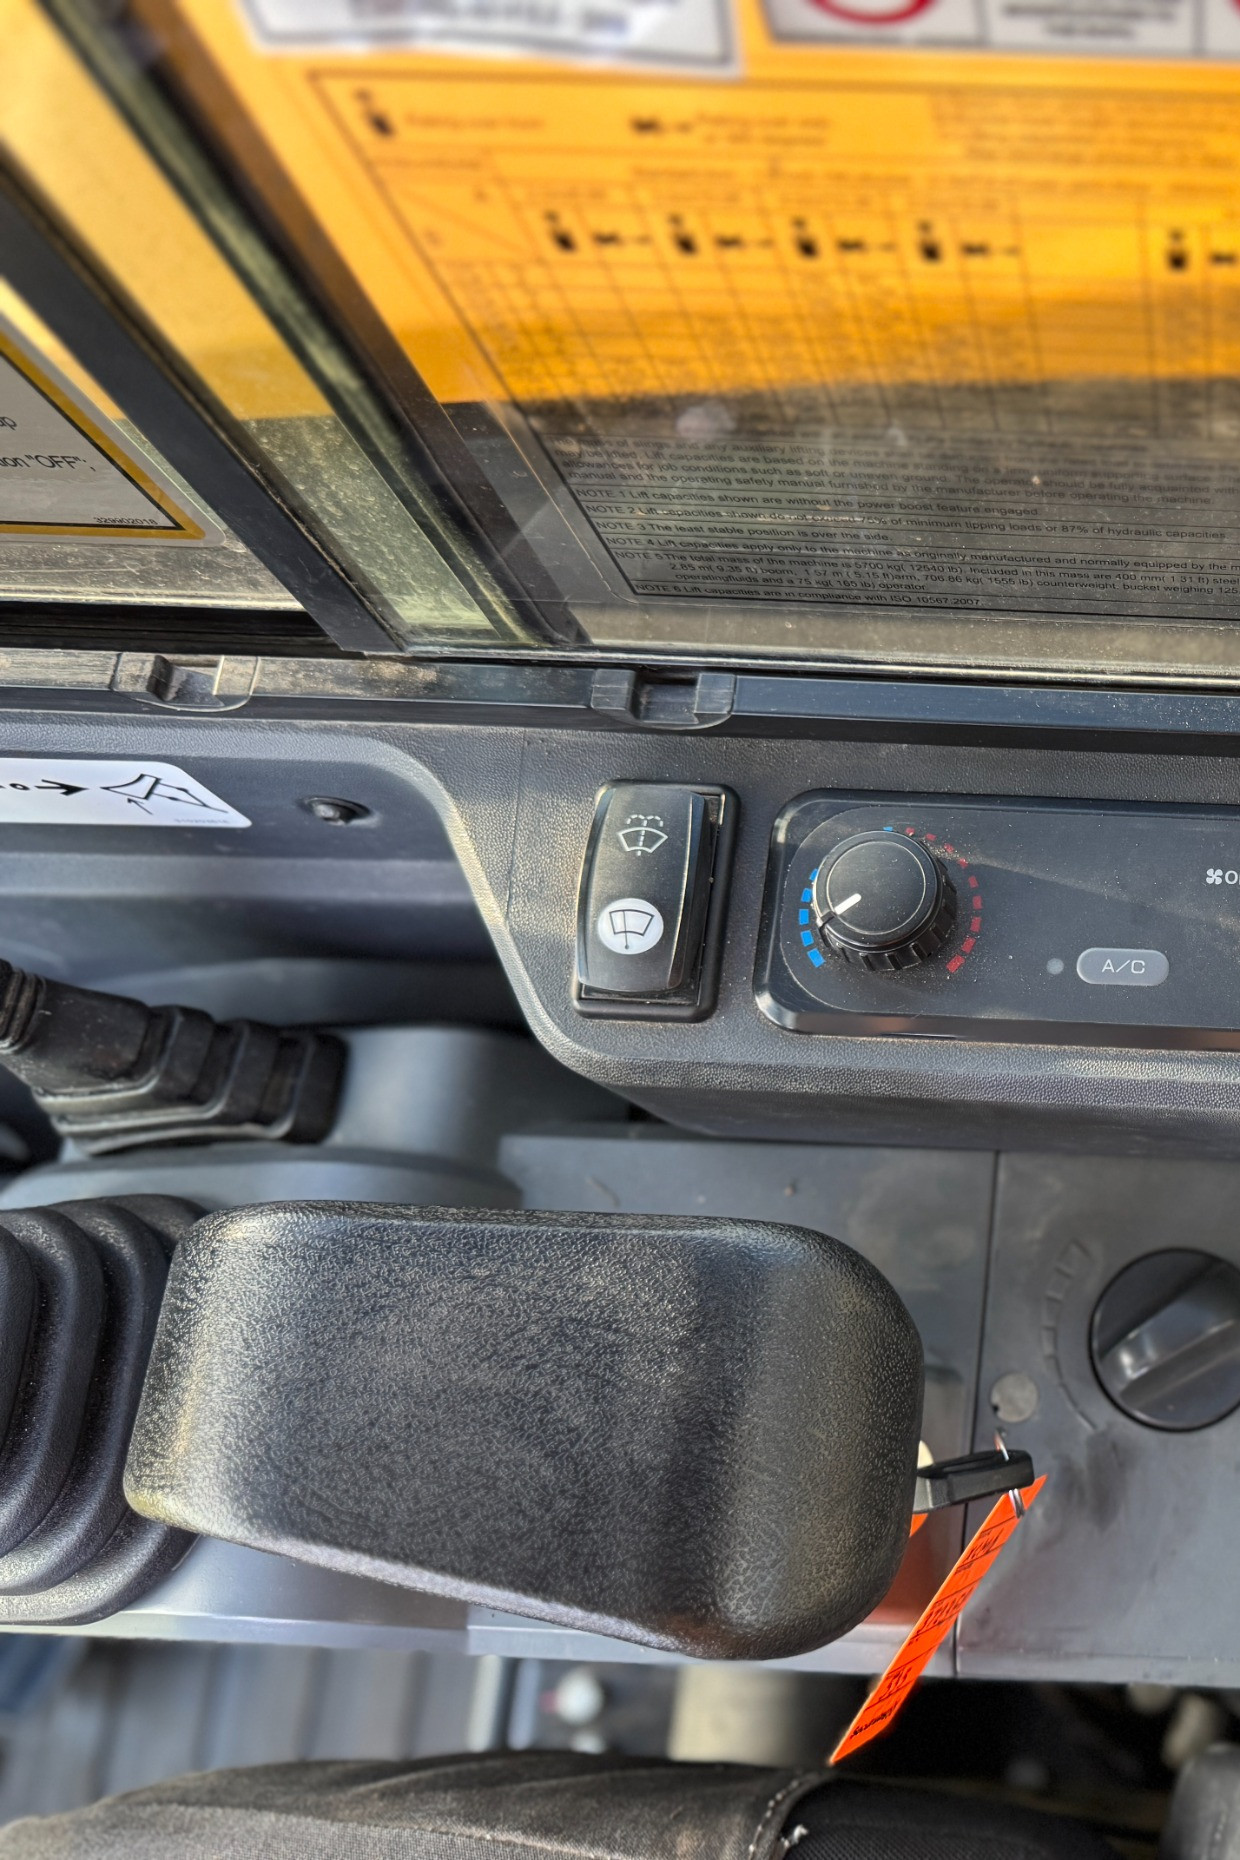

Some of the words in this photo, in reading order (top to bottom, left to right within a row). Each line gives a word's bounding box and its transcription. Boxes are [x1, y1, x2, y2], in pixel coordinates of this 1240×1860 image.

[574, 488, 617, 498] NOTE
[629, 491, 650, 499] Lift
[651, 492, 715, 504] capacities
[716, 494, 759, 504] shown
[785, 497, 830, 507] without
[832, 499, 854, 508] the
[857, 500, 896, 511] power
[898, 502, 933, 511] boost
[935, 504, 980, 513] feature
[585, 504, 627, 514] NOTE
[905, 518, 962, 528] minimum
[963, 520, 1006, 531] tipping
[1008, 522, 1042, 531] loads
[1060, 525, 1089, 533] 87%
[1105, 527, 1162, 538] hydraulic
[594, 521, 634, 530] NOTE
[647, 523, 672, 532] The
[707, 526, 744, 535] stable
[747, 527, 795, 539] position
[810, 531, 837, 539] over
[839, 531, 861, 540] the
[604, 537, 642, 546] NOTE
[741, 542, 774, 553] apply
[818, 546, 839, 554] the
[969, 552, 1051, 563] manufactured
[1053, 556, 1076, 564] and
[1079, 557, 1130, 568] normally
[1132, 559, 1187, 571] equipped
[1207, 562, 1227, 571] the
[614, 551, 652, 560] NOTE
[787, 559, 839, 568] machine
[968, 566, 1019, 575] Included
[1034, 569, 1056, 577] this
[1114, 572, 1137, 580] 400
[1211, 577, 1240, 585] steel
[634, 584, 672, 592] NOTE
[797, 591, 861, 602] compliance
[864, 593, 888, 601] with
[889, 594, 912, 602] ISO
[1122, 582, 1161, 591] bucket
[1162, 584, 1214, 595] weighing
[1101, 959, 1146, 974] A/C
